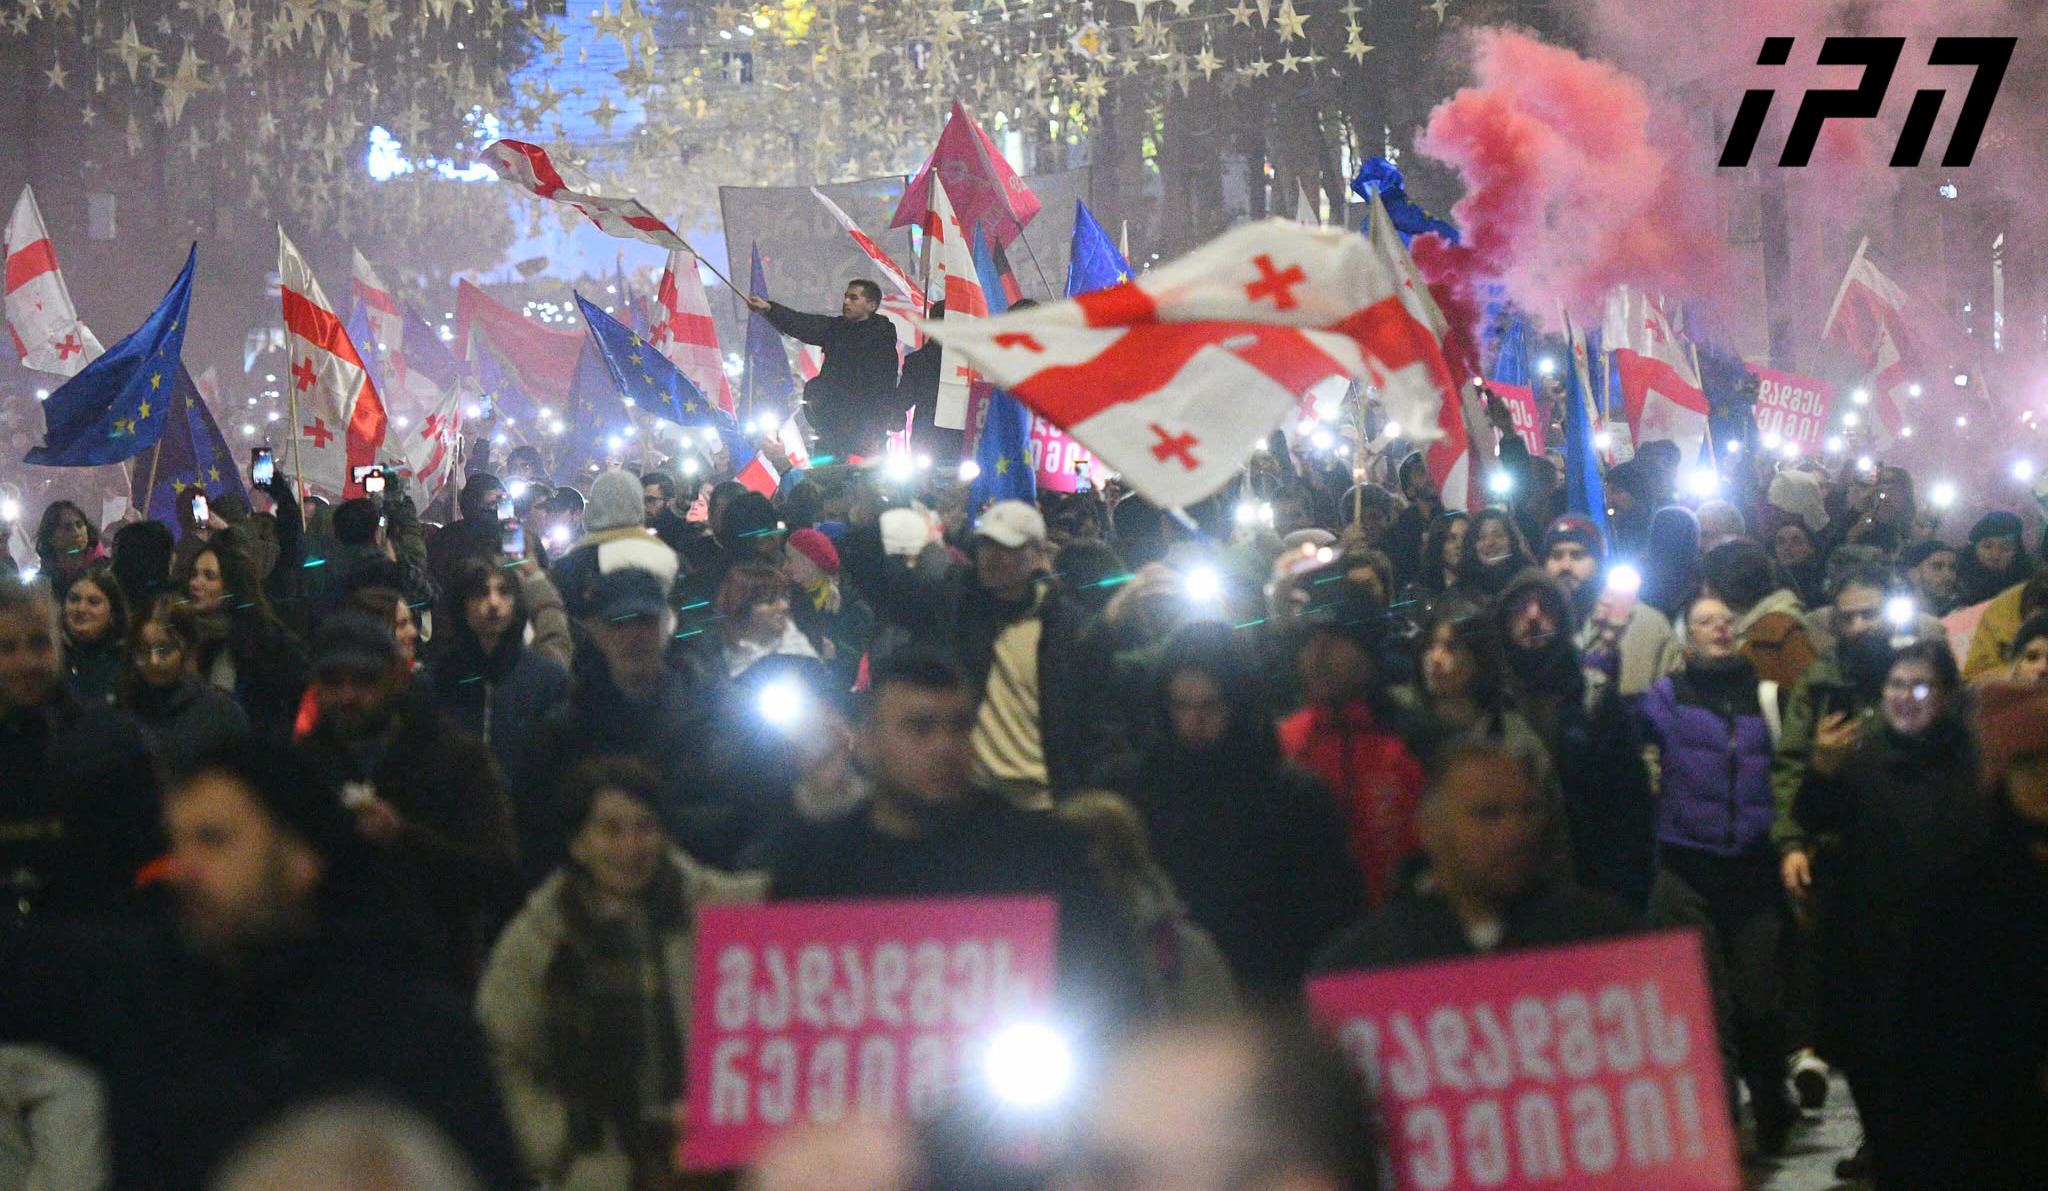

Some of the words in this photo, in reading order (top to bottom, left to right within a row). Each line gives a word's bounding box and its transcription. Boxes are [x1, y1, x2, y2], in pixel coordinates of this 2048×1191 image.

[1758, 380, 1824, 416] დადგეს
[1752, 405, 1820, 443] ჟიმი!
[1382, 1072, 1708, 1191] ეჟიმი!
